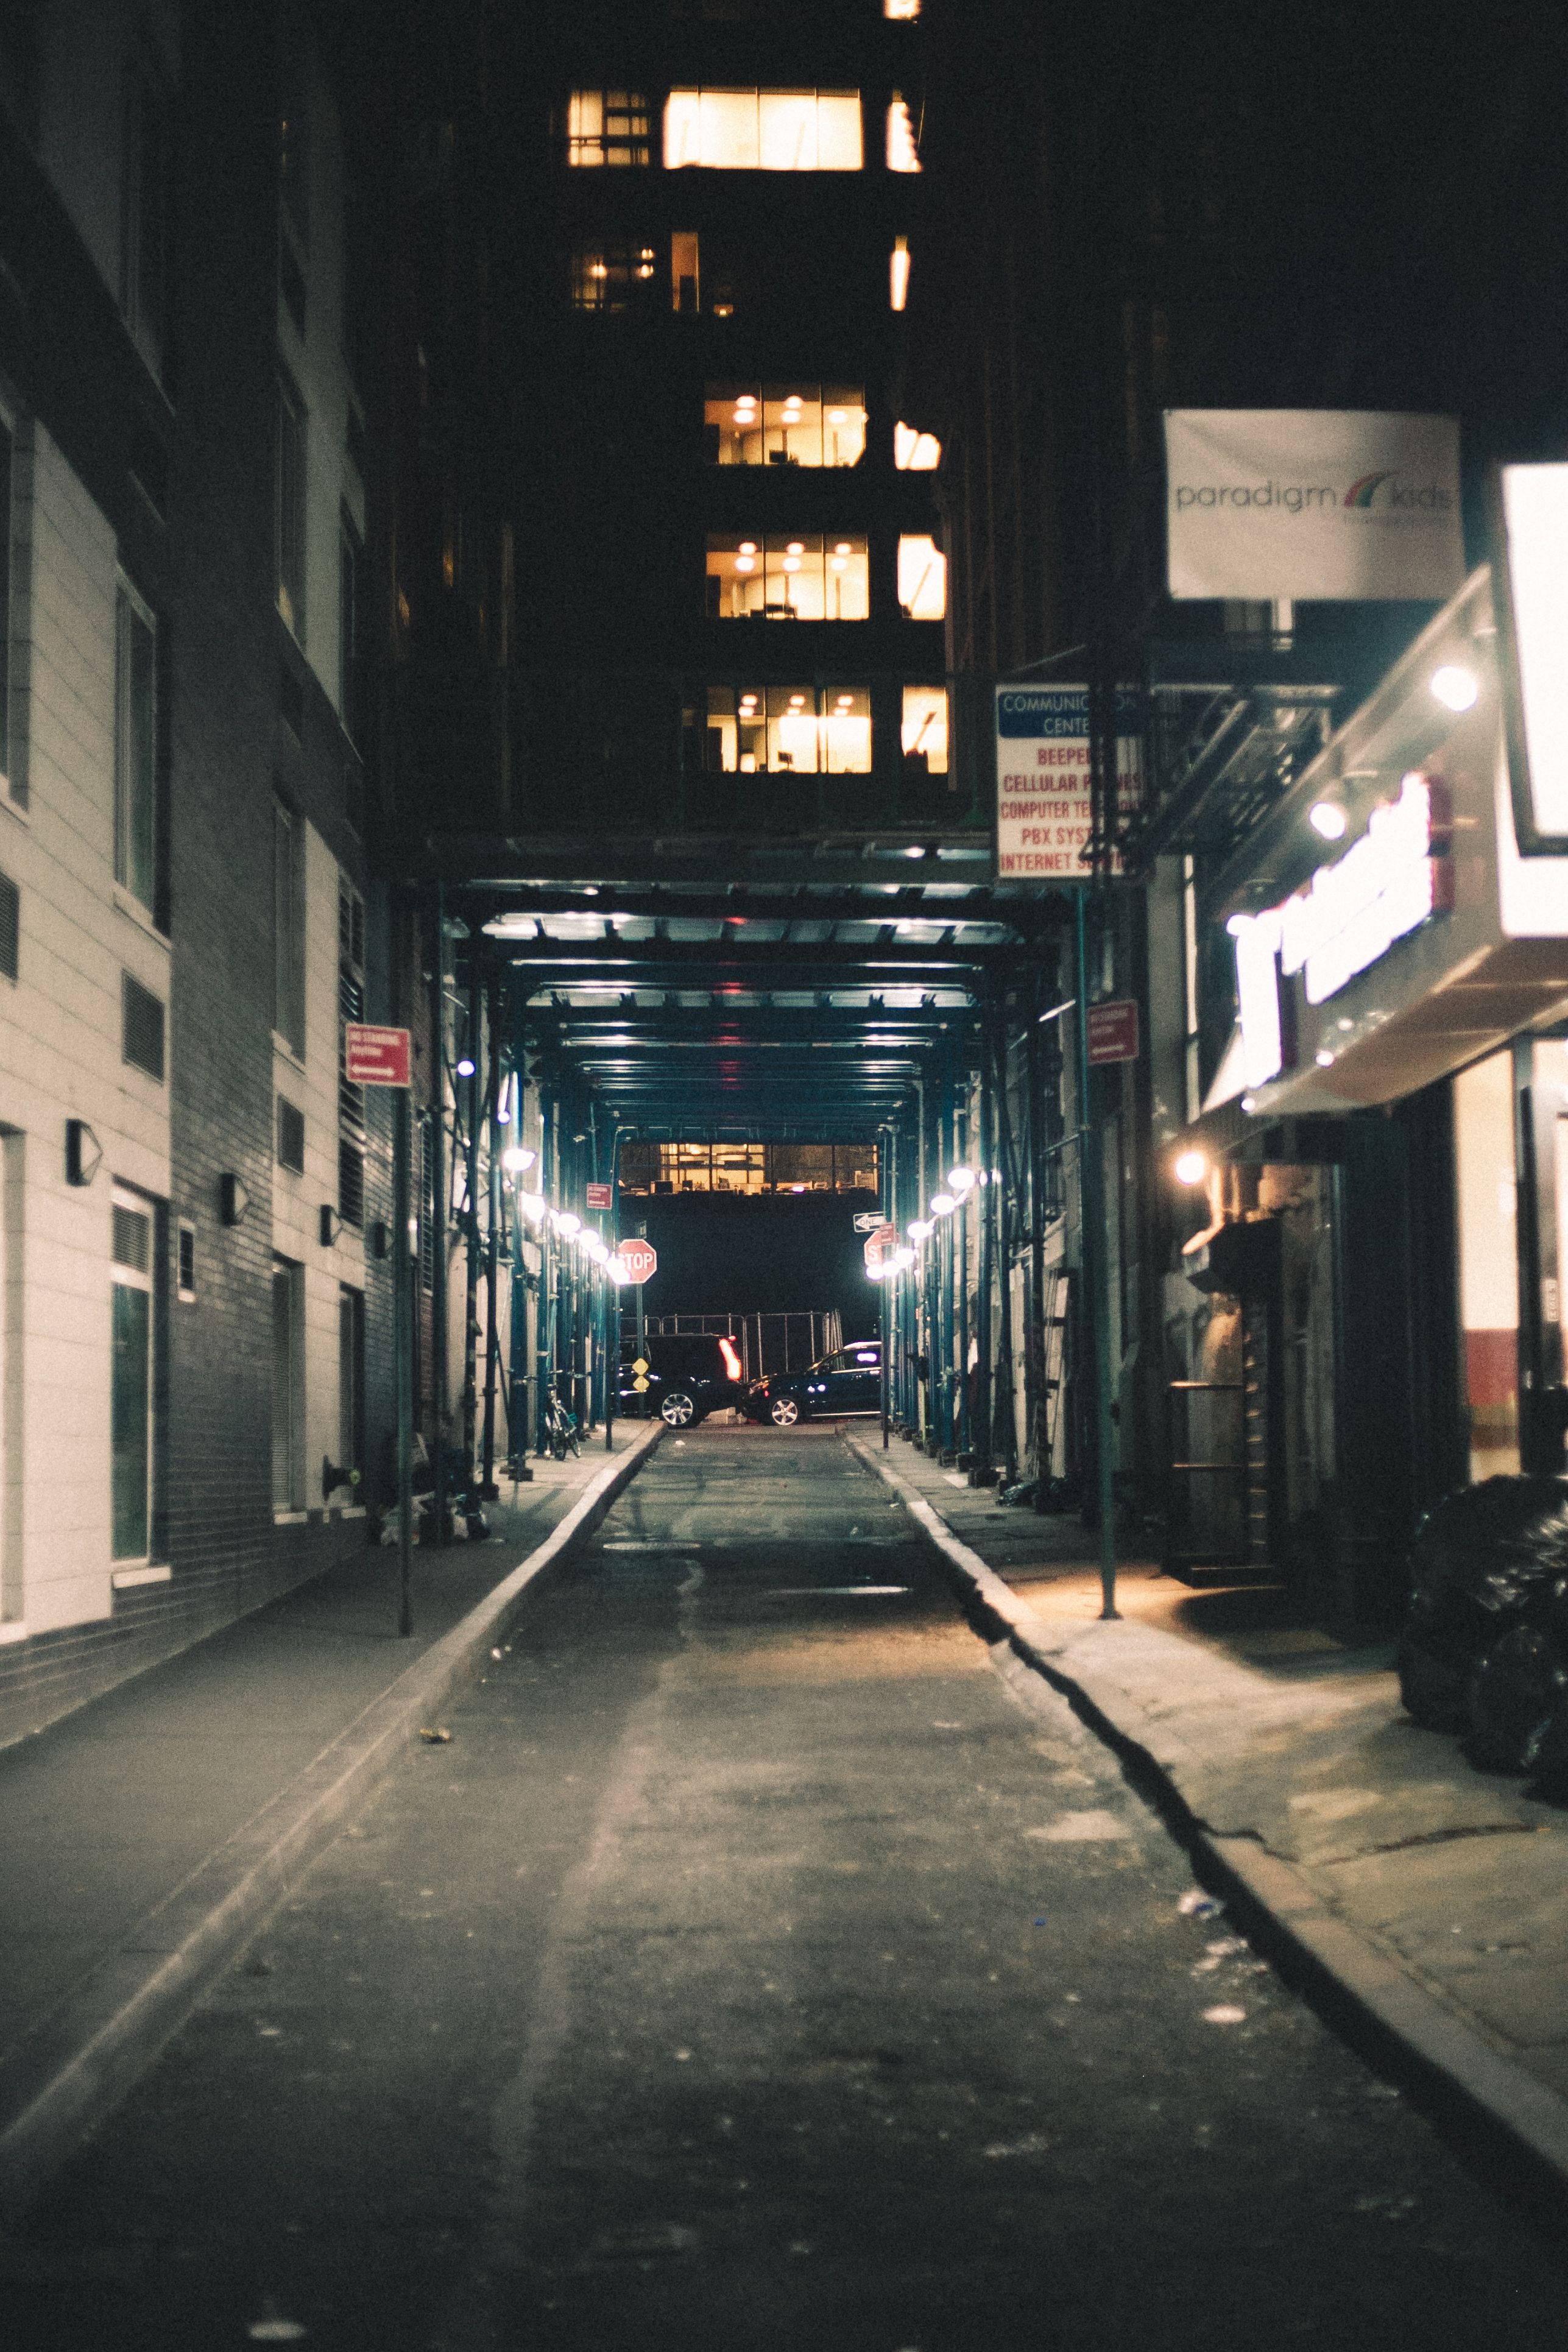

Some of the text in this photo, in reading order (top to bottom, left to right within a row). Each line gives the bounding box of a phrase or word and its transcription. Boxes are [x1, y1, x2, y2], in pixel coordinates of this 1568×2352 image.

[1177, 480, 1336, 513] paradigm
[1044, 718, 1090, 735] CENTE
[1003, 774, 1078, 793] CELLULAR
[1001, 800, 1068, 819] COMPUTER
[1022, 827, 1051, 845] PBX
[1001, 853, 1071, 871] INTERNET
